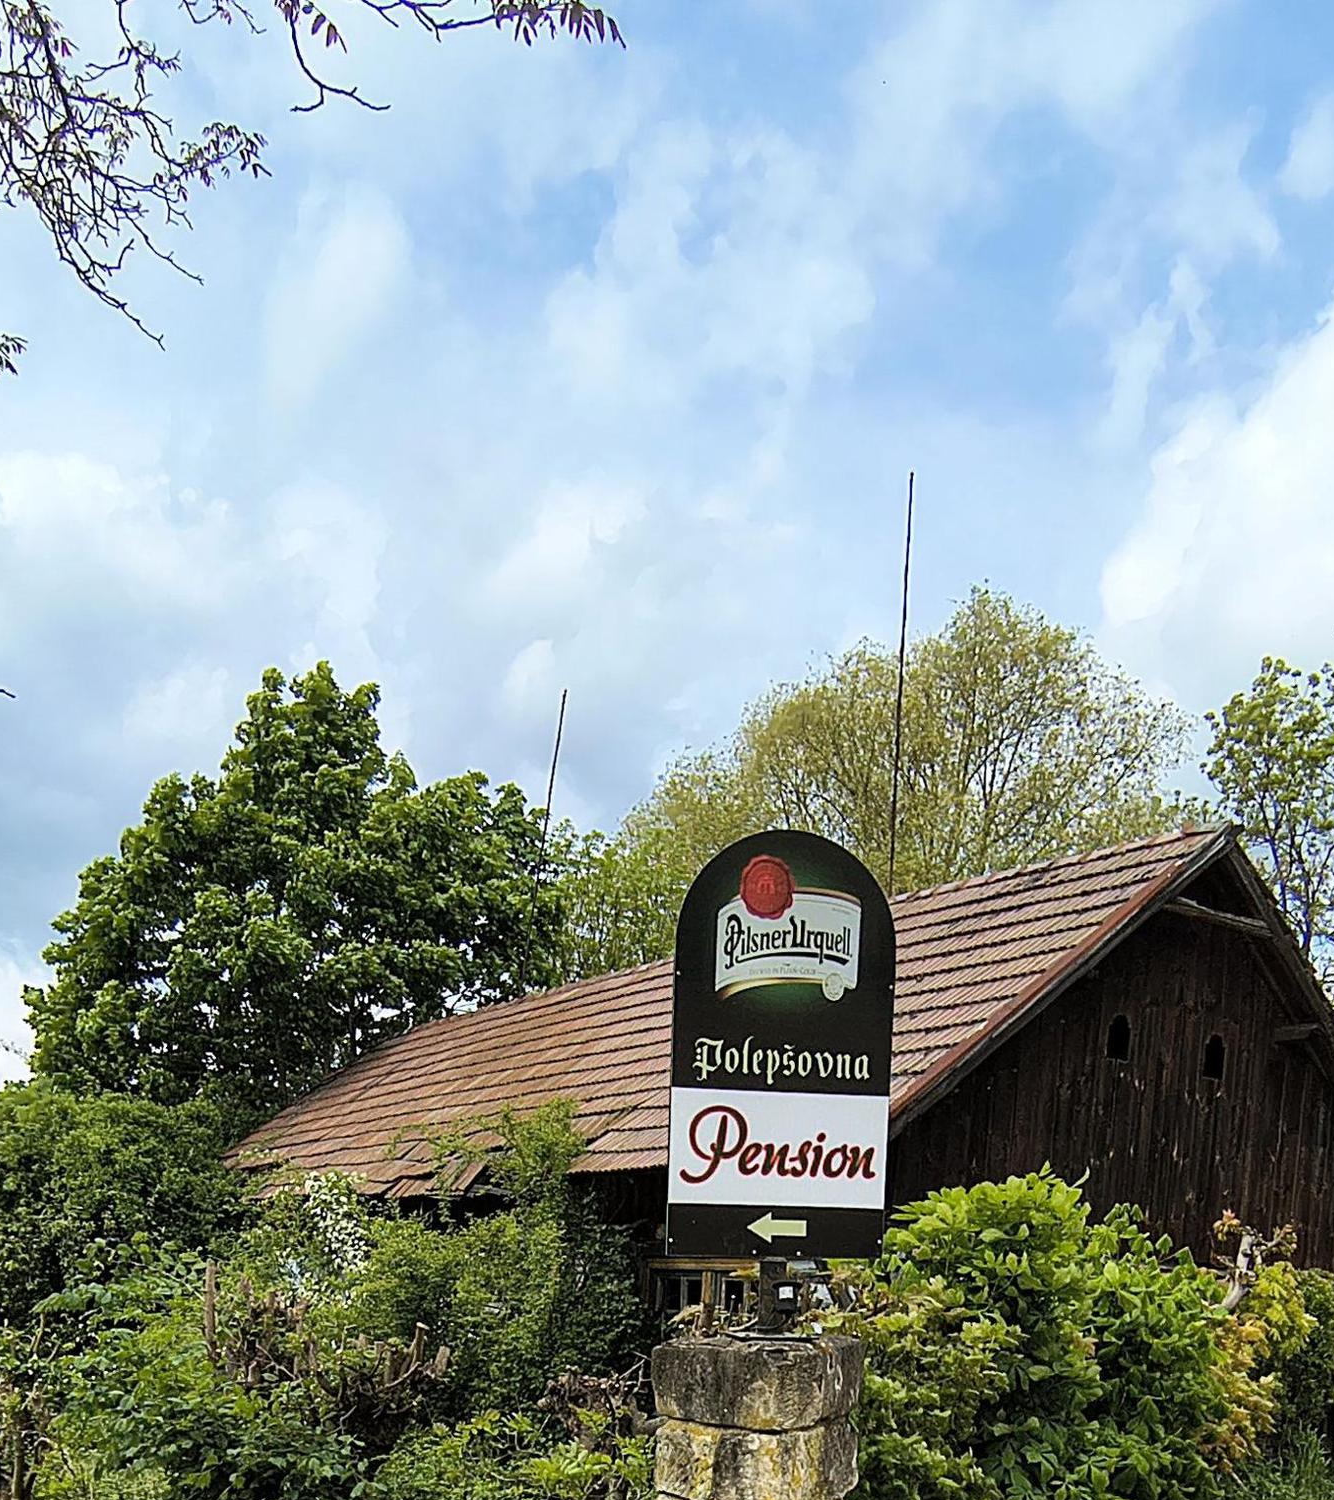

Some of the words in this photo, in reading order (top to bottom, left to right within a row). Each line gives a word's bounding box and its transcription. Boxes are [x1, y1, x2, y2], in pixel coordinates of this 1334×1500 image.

[723, 913, 791, 970] Pilsner
[693, 1036, 870, 1084] Polepšovna
[679, 1105, 876, 1184] Pension
